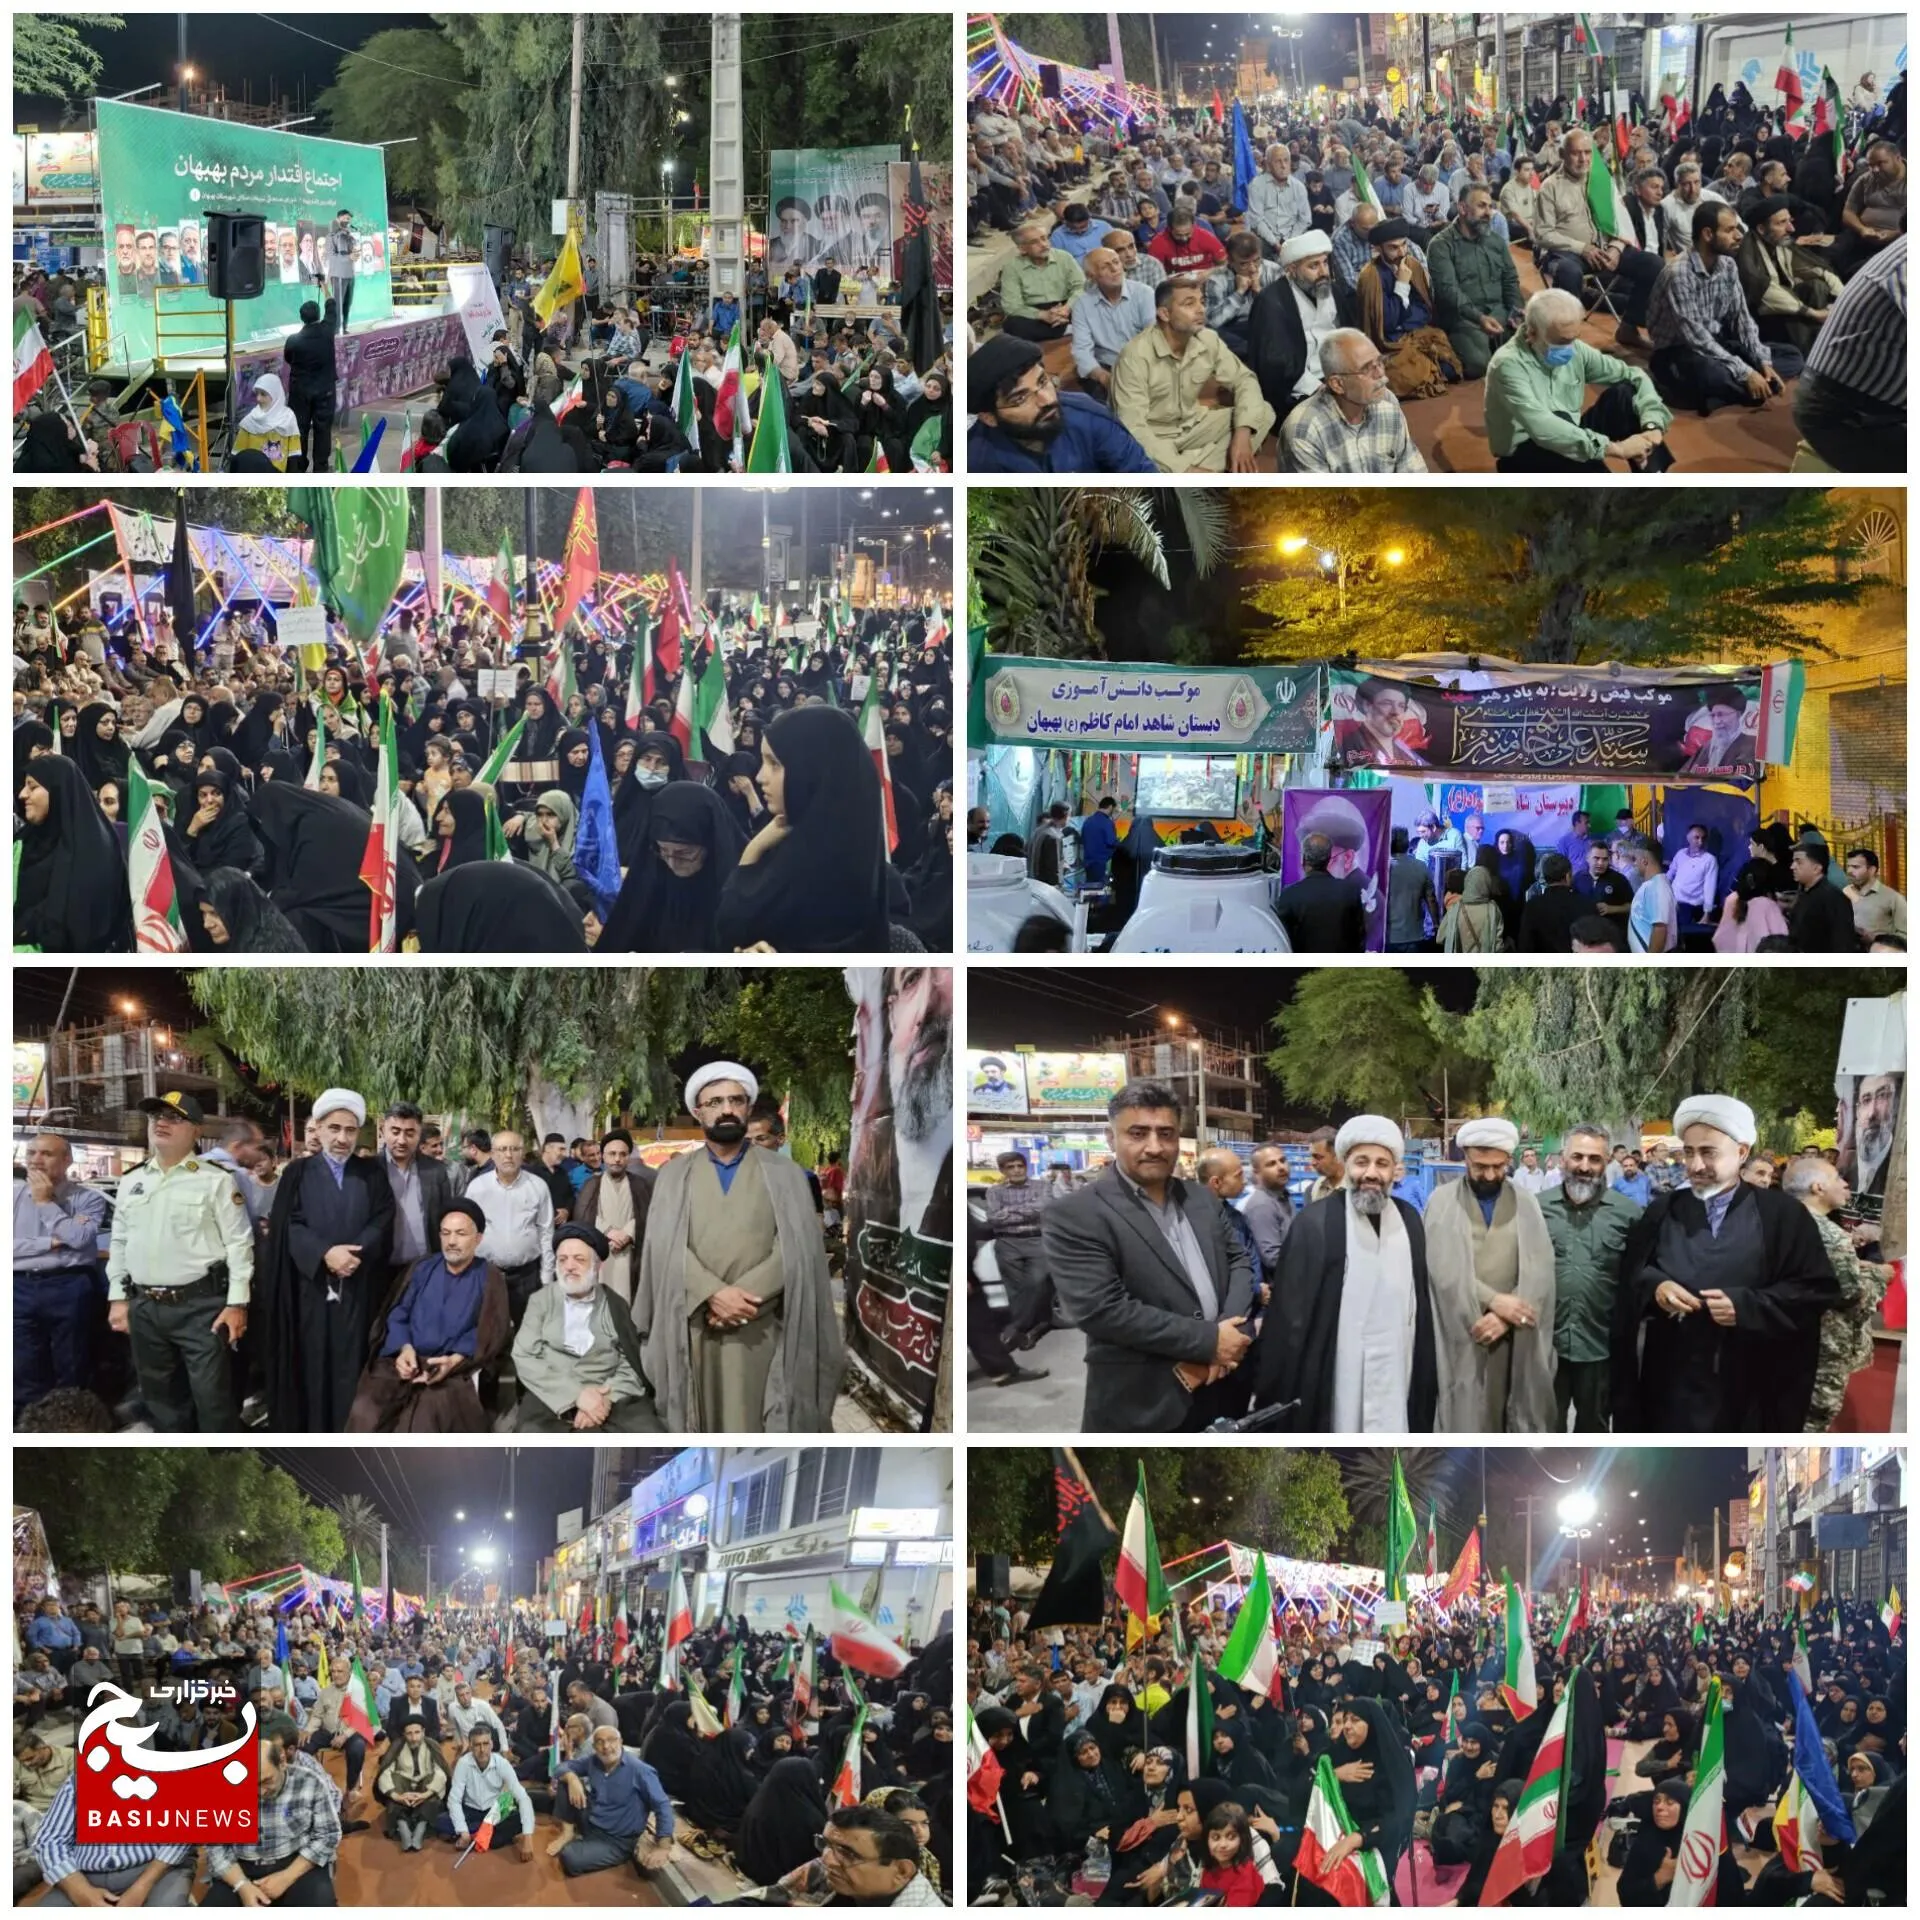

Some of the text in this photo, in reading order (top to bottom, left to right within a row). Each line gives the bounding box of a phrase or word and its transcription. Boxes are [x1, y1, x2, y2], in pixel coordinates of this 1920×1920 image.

[174, 153, 343, 194] اجتماع اقتدار مردم بهبهان
[1107, 679, 1153, 701] دانش
[1154, 680, 1200, 702] موکب
[1513, 685, 1533, 701] یاد
[1536, 684, 1549, 701] به
[1600, 686, 1631, 704] فیض
[1026, 709, 1062, 734] بهبهان
[1079, 711, 1113, 735] کاظم
[1114, 712, 1139, 736] امام
[1143, 714, 1175, 731] شاهد
[1178, 714, 1221, 738] دبستان
[1535, 790, 1574, 817] دبیرستان
